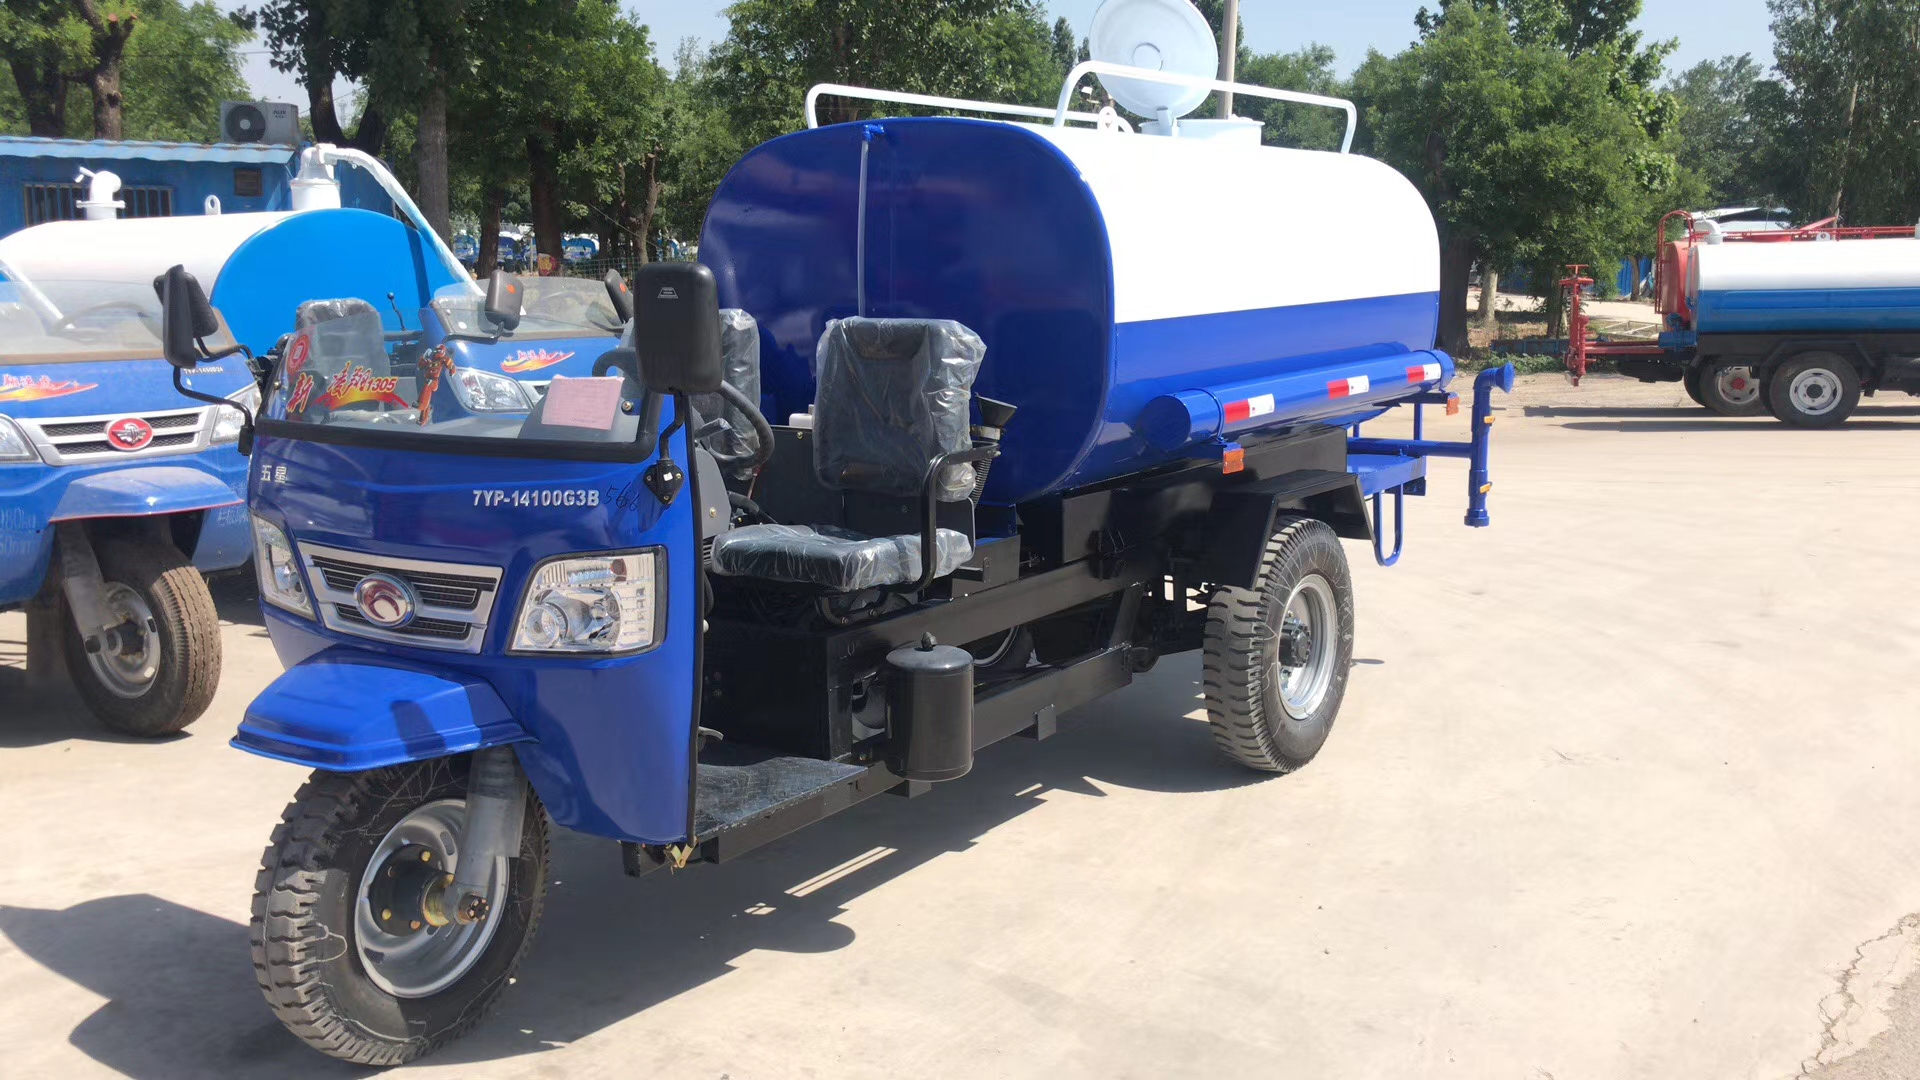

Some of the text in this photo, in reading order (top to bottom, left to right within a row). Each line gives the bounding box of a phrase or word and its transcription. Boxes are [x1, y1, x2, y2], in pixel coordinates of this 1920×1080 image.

[286, 372, 315, 413] 新
[261, 464, 288, 484] 五星
[472, 489, 600, 507] 7YP-14100G3B
